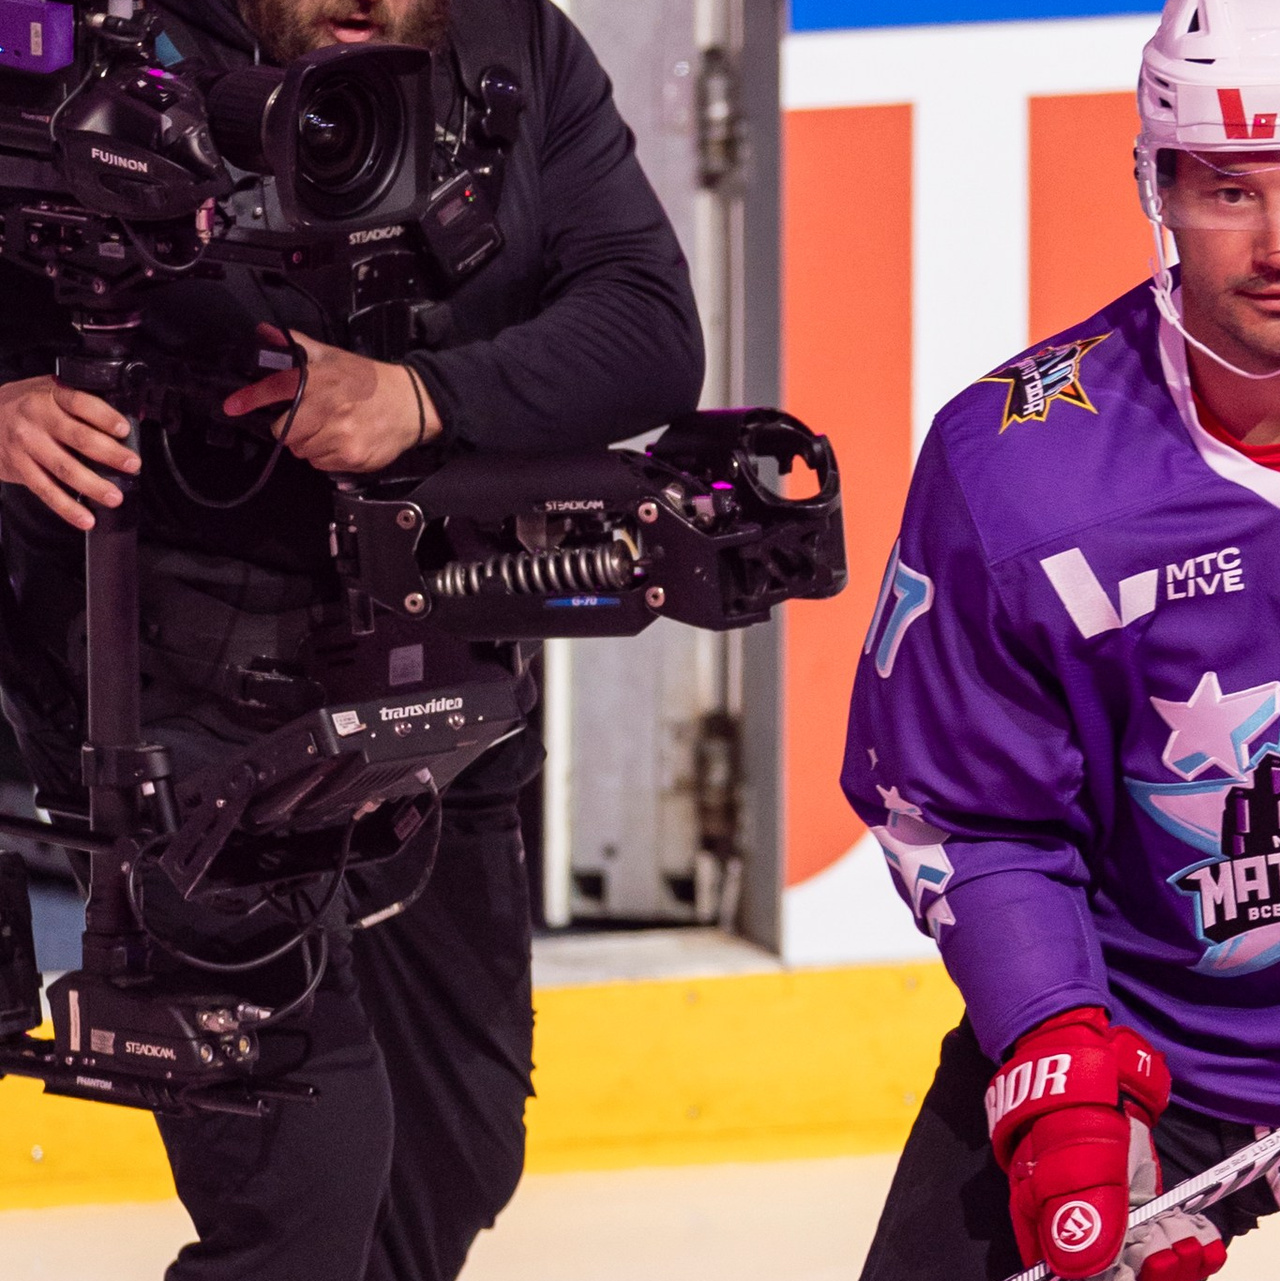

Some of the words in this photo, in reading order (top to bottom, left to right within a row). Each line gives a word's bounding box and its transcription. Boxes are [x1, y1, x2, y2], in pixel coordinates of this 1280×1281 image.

[91, 147, 148, 173] FUJINON
[545, 500, 604, 511] STEADICAM
[1166, 568, 1245, 601] LIVE
[379, 697, 463, 721] transvideo
[125, 1041, 176, 1060] STEADICAM
